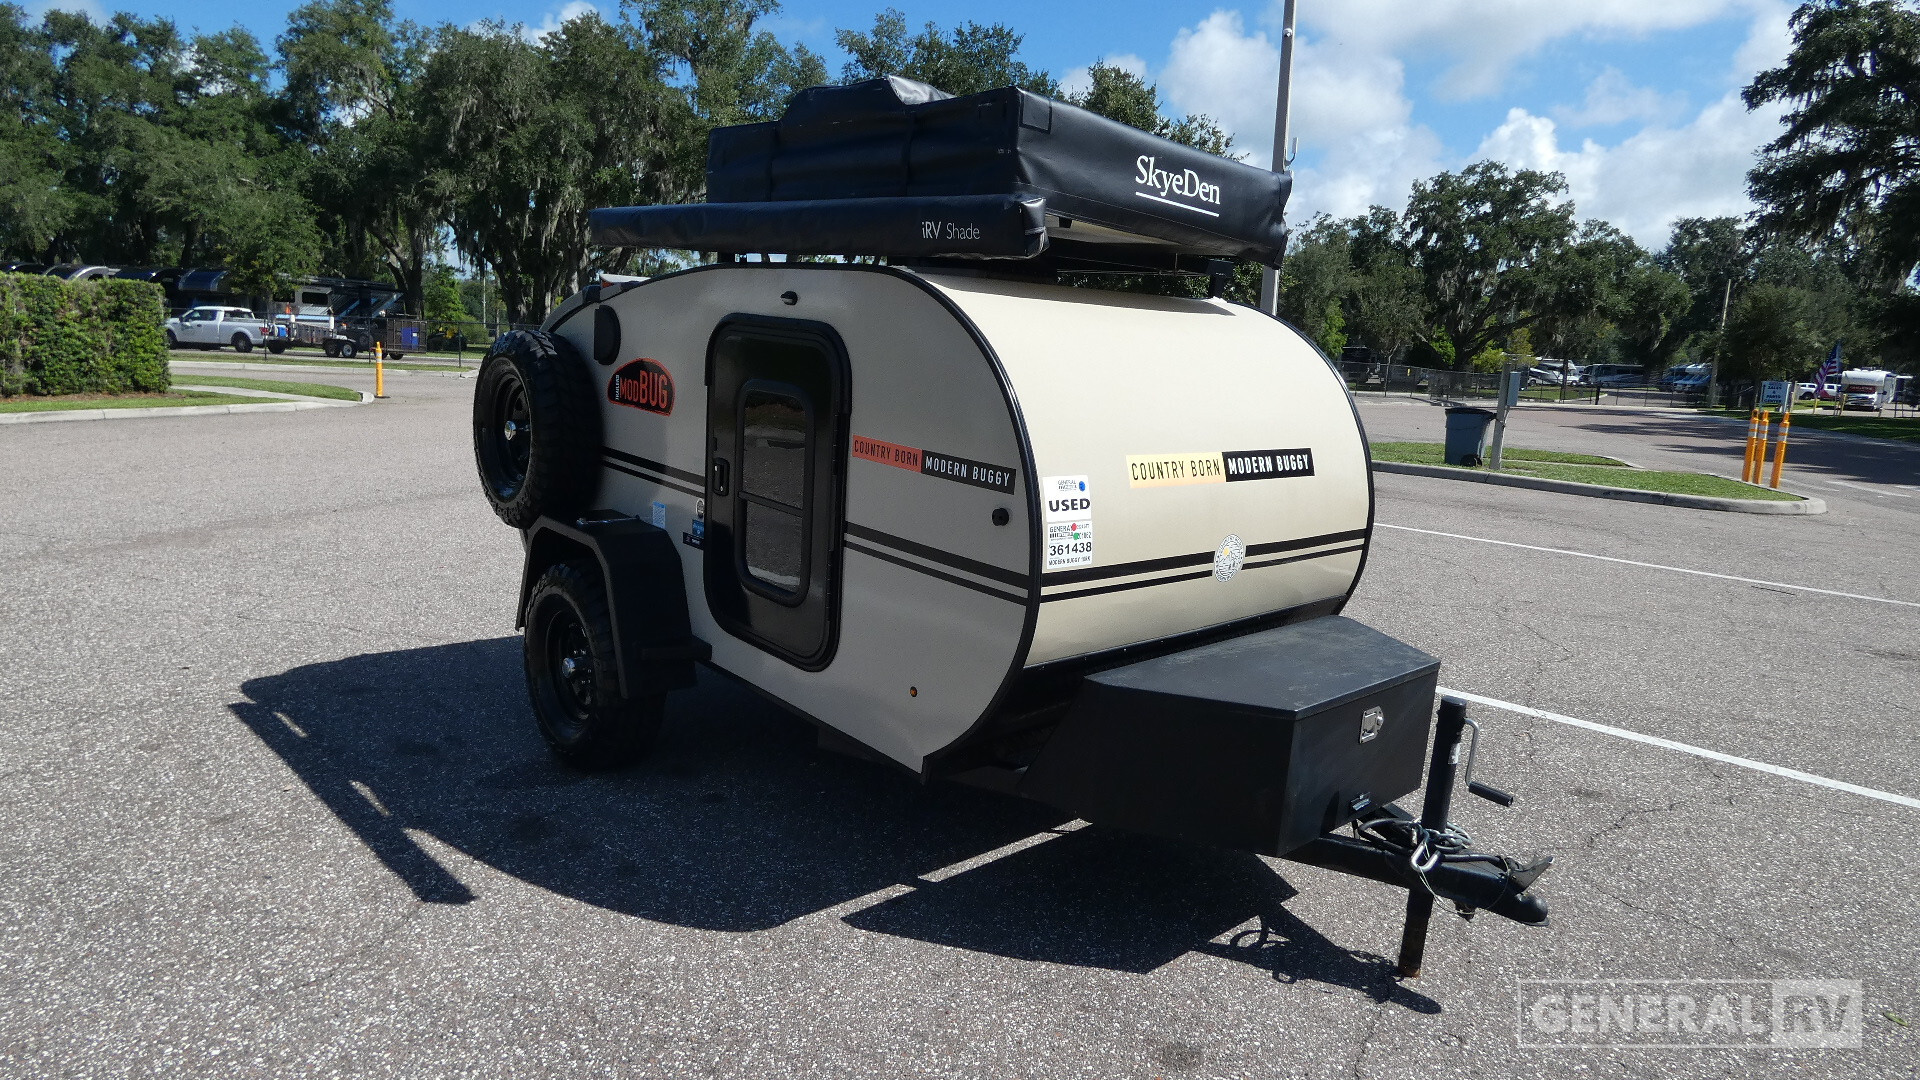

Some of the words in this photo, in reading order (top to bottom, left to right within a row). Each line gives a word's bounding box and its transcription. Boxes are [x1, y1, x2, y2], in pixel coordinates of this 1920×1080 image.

[1135, 154, 1221, 205] SkyeDen
[921, 220, 941, 240] iRV
[946, 222, 980, 241] Shade
[854, 439, 891, 460] COUNTRY
[894, 449, 918, 467] BORN
[925, 455, 967, 478] MODERN
[972, 466, 1010, 487] BUGGY
[1131, 460, 1185, 481] COUNTRY
[1190, 458, 1221, 478] BORN
[1227, 455, 1273, 475] MODERN
[1276, 454, 1309, 472] BUGGY
[1048, 498, 1091, 513] USED
[1049, 542, 1092, 556] 361438
